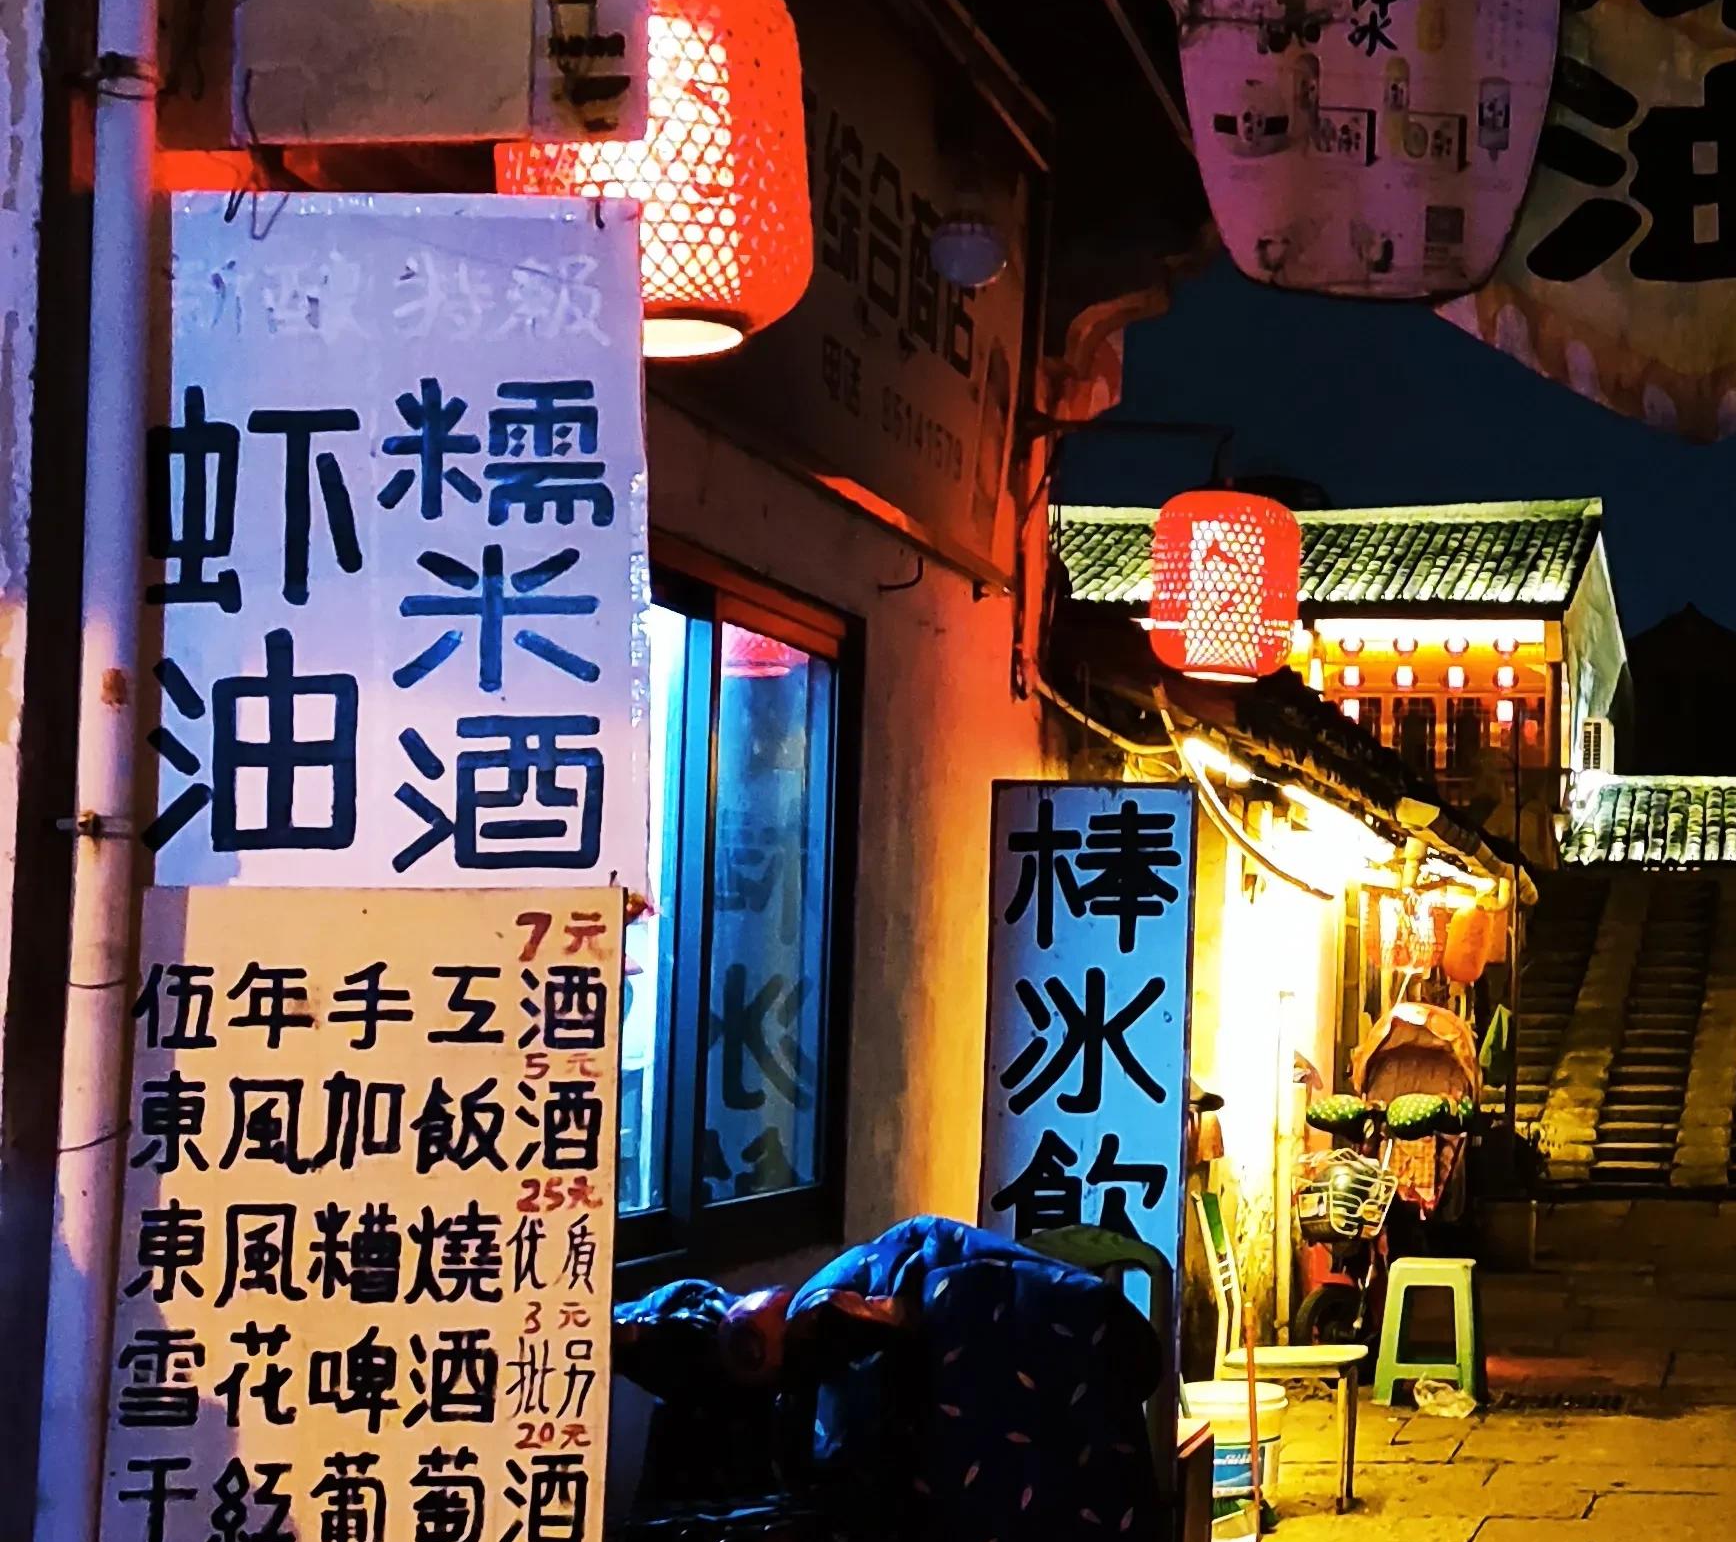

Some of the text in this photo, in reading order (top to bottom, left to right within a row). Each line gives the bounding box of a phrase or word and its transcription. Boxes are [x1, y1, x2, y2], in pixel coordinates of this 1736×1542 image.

[143, 386, 364, 852] 虾油
[377, 377, 615, 873] 糯米酒
[515, 911, 612, 962] 7元
[132, 961, 607, 1050] 伍年手工酒
[523, 1052, 604, 1080] 5元
[516, 1175, 604, 1213] 25元
[523, 1300, 592, 1335] 3元
[116, 1321, 499, 1433] 雪花啤酒
[514, 1421, 592, 1451] 20元
